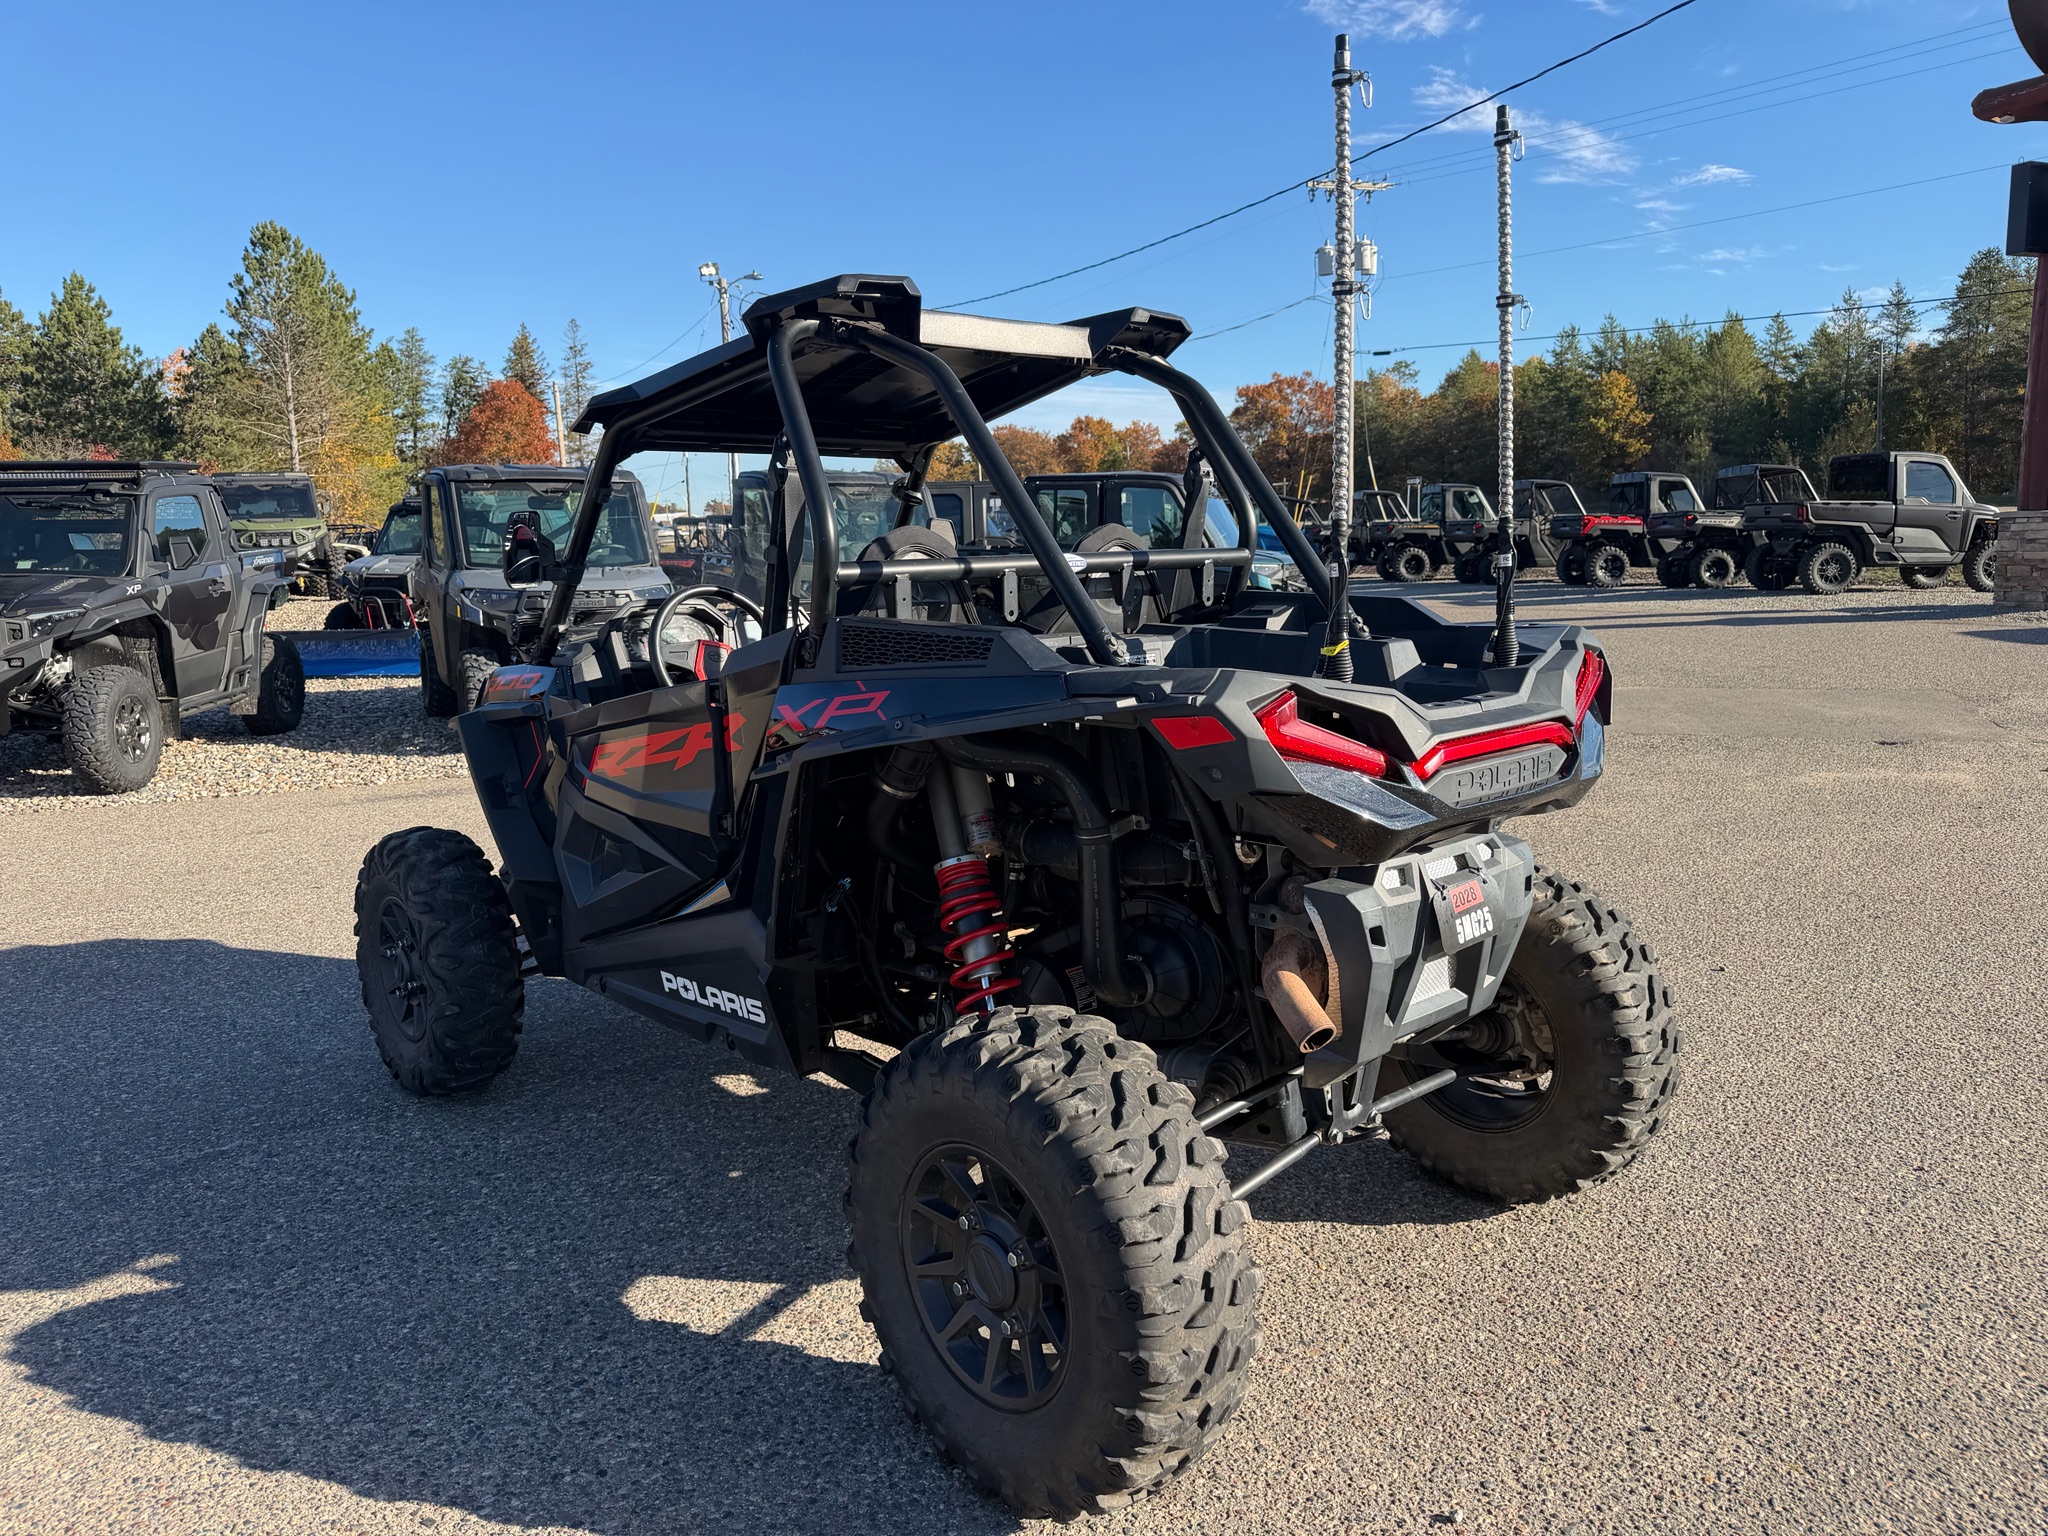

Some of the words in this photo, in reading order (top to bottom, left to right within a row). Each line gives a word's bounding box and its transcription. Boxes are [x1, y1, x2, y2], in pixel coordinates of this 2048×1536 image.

[126, 584, 142, 596] XP
[573, 599, 605, 607] LARIS
[766, 690, 891, 737] XP
[591, 712, 747, 778] RZR
[1455, 752, 1553, 798] POLARIS
[1452, 886, 1477, 908] 2028
[1455, 906, 1494, 944] 5MG25
[660, 970, 766, 1024] POLARIS
